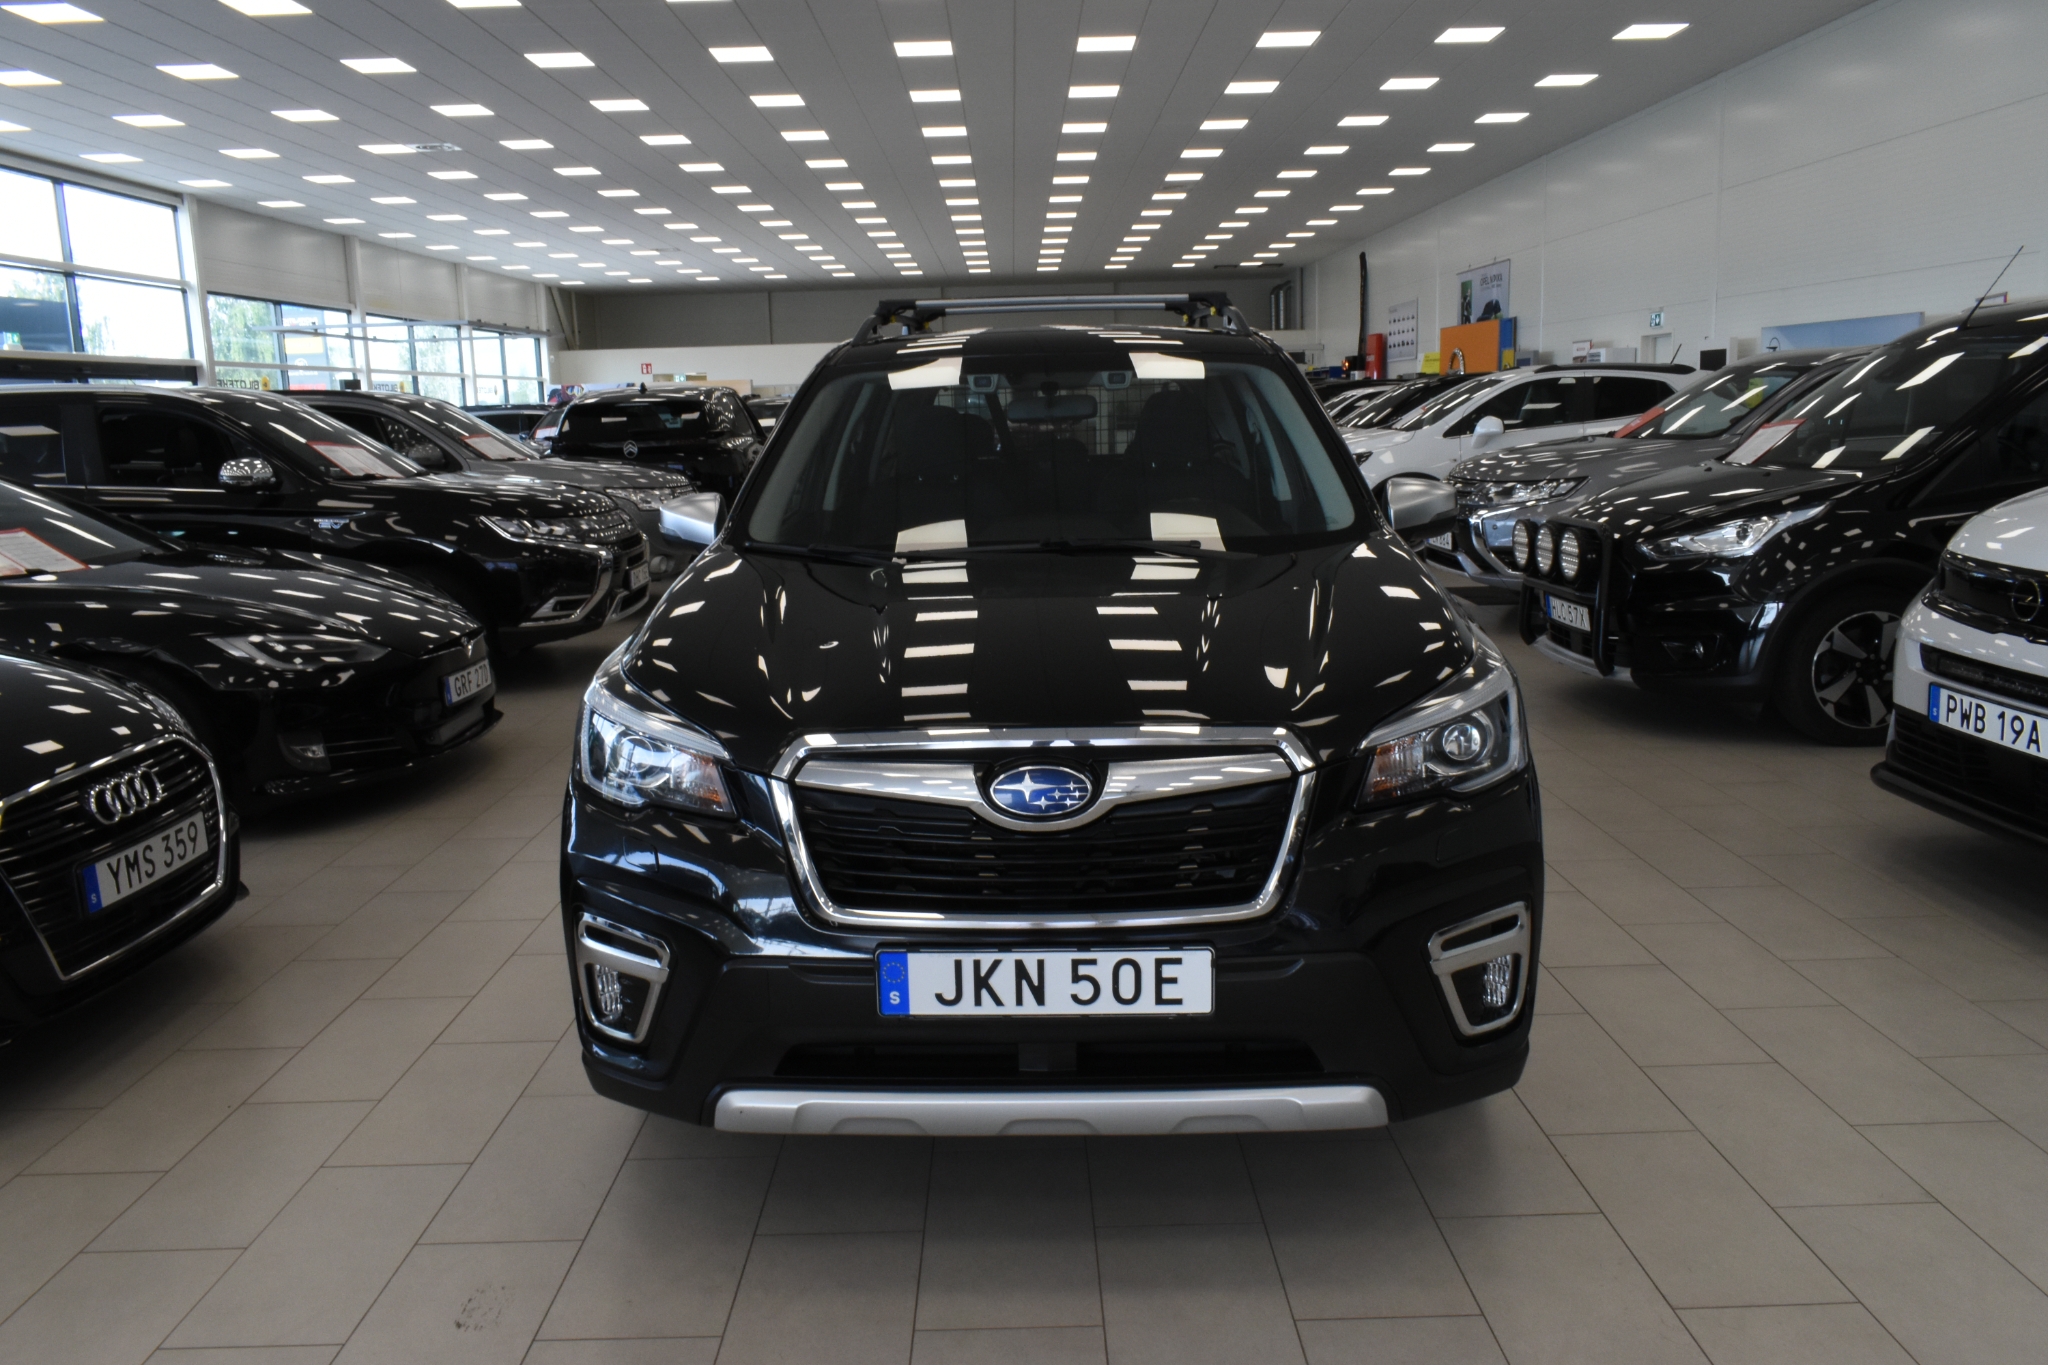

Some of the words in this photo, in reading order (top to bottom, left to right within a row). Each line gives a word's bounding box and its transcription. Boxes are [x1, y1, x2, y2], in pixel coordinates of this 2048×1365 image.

[454, 671, 473, 697] GRF
[1946, 694, 1986, 734] PWB
[1997, 710, 2041, 753] 19A
[106, 844, 156, 895] YMS
[161, 821, 198, 869] 359
[889, 991, 900, 1005] S
[934, 958, 1046, 1007] JKN
[1070, 957, 1183, 1006] 50E
